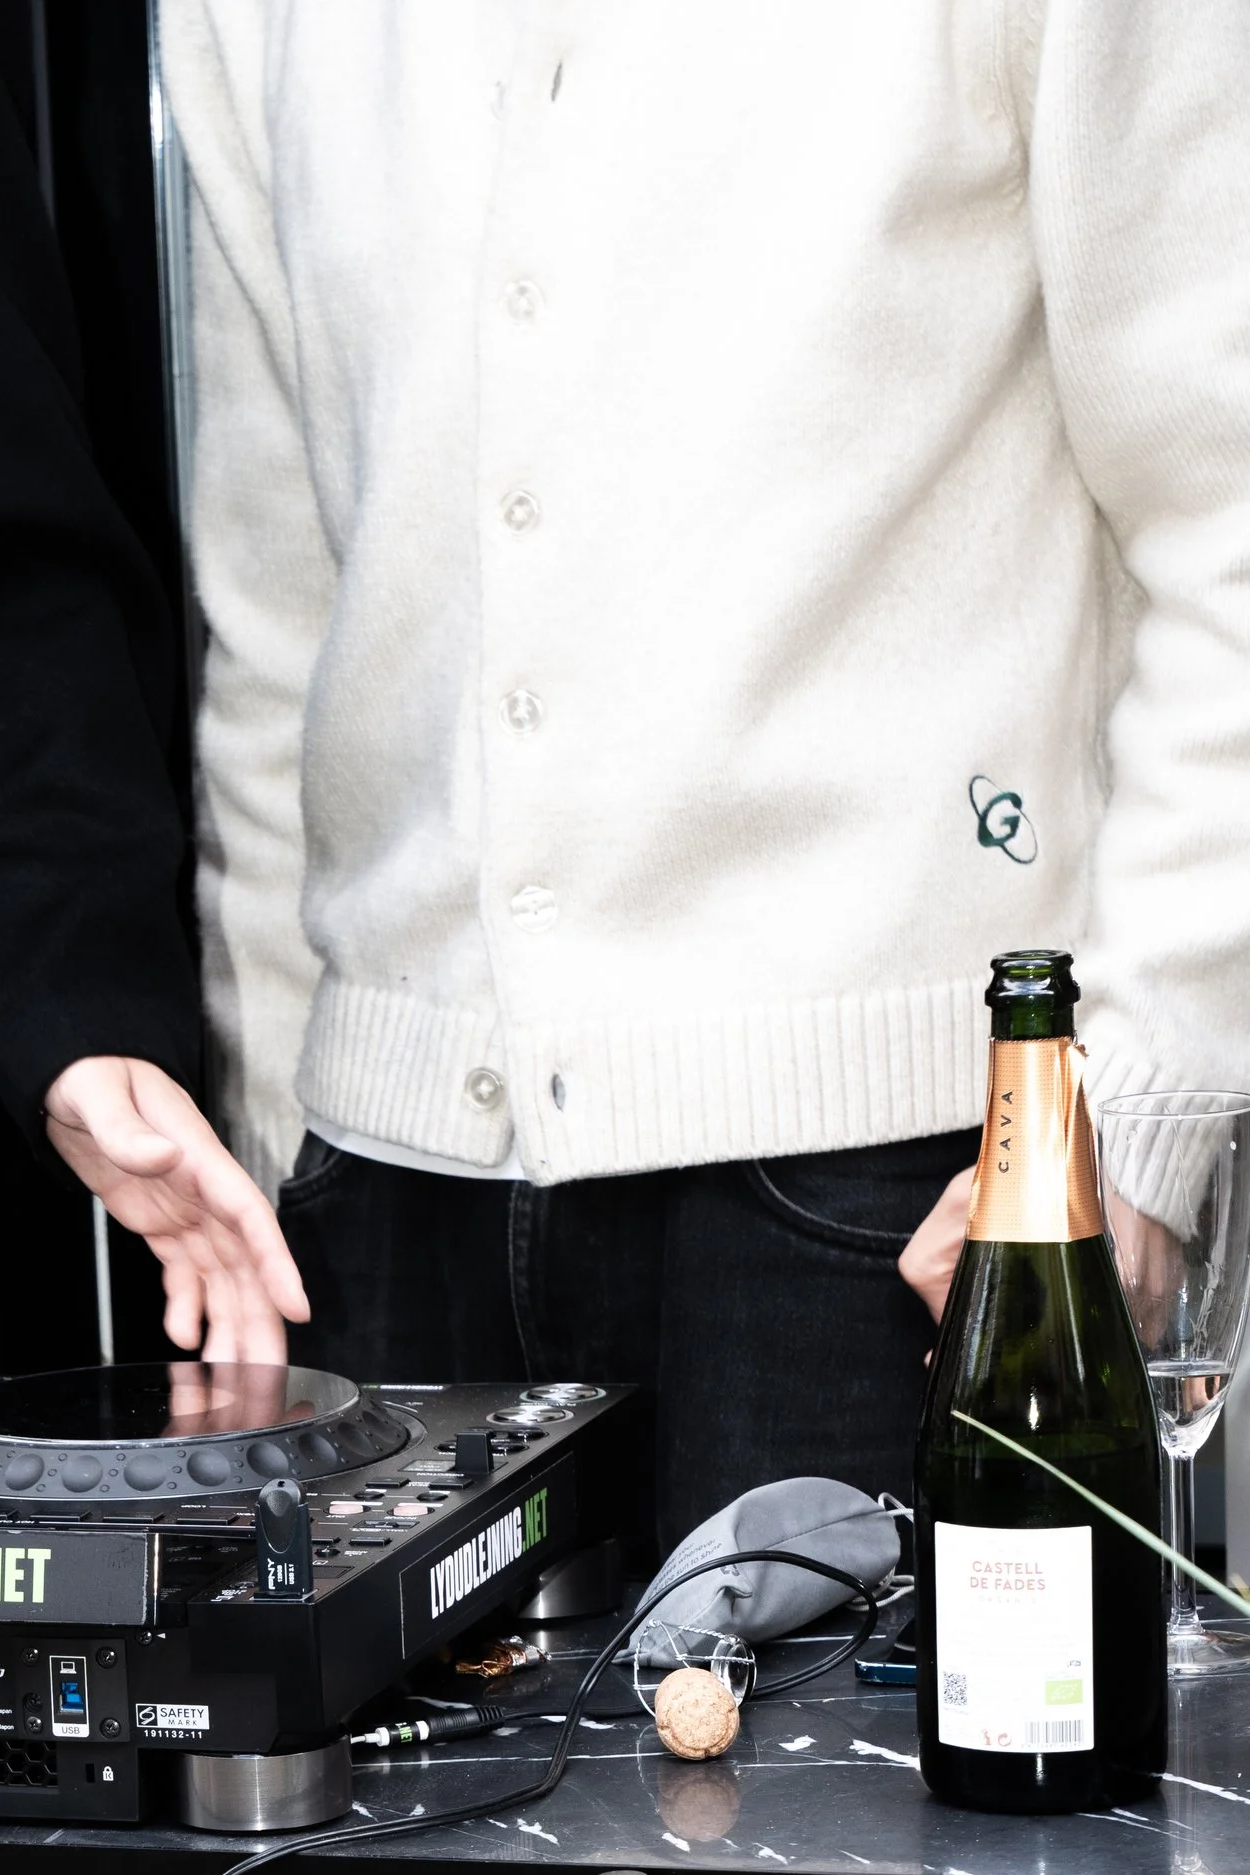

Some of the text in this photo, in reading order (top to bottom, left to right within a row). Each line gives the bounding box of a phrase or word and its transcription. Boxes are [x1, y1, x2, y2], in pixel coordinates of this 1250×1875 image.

[998, 1091, 1013, 1173] CAVA
[430, 1487, 548, 1619] LYDUDLEJNING.NET
[267, 1558, 276, 1589] PNY
[972, 1560, 1043, 1575] CASTELL
[970, 1576, 1046, 1591] DE FADES
[160, 1708, 204, 1718] SAFETY
[62, 1726, 80, 1735] USB
[144, 1729, 202, 1739] 191132-11
